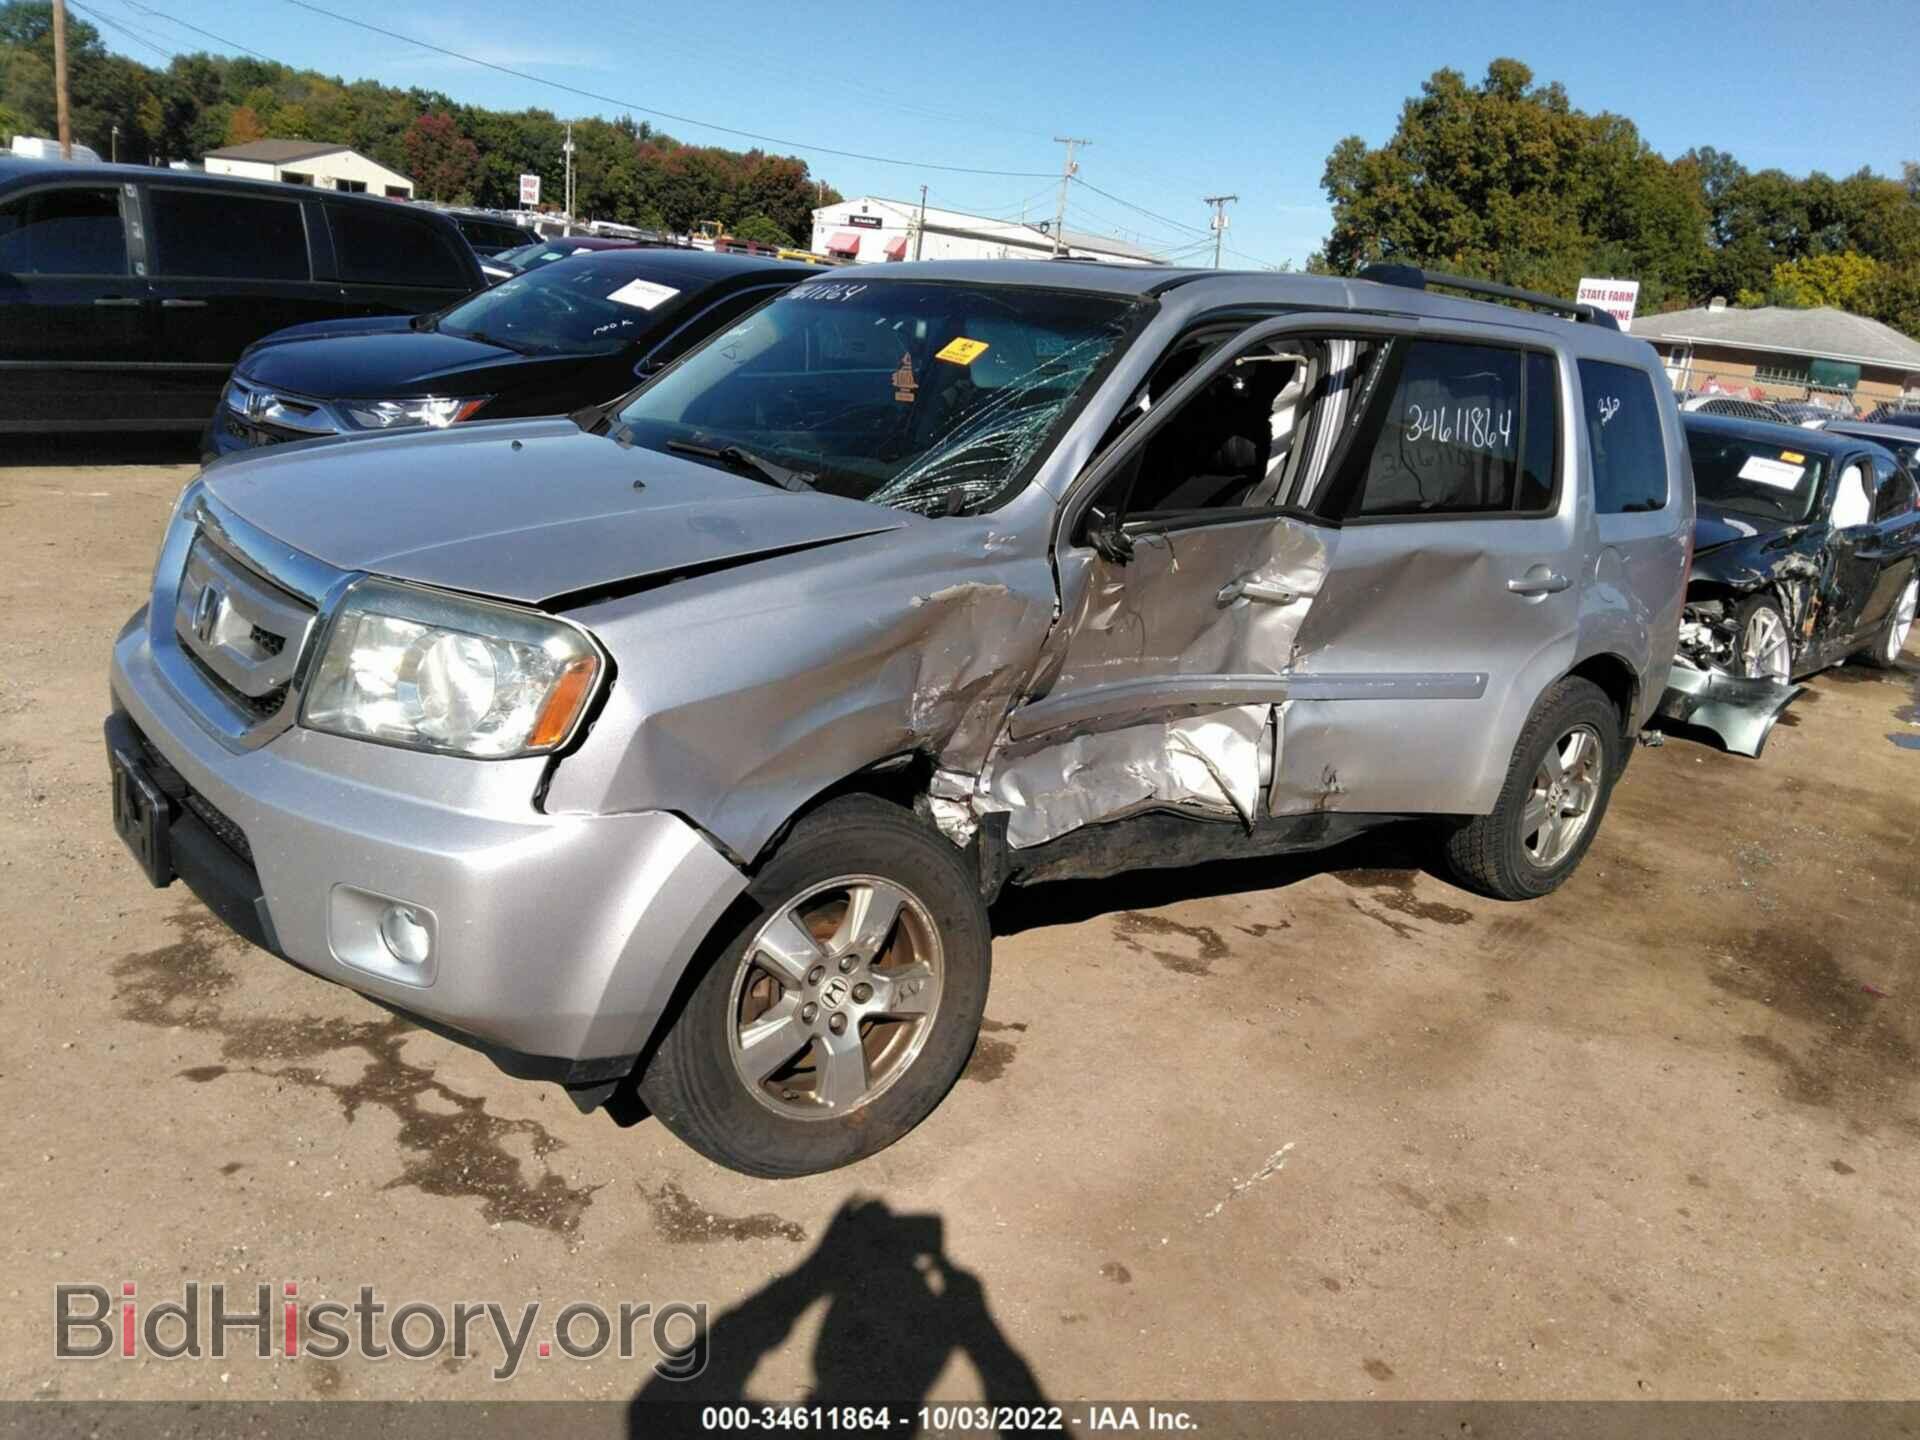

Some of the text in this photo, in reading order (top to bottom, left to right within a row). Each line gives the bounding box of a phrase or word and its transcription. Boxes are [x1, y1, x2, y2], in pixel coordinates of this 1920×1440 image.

[1580, 288, 1633, 302] STATE FARM
[1406, 404, 1512, 448] 34611864
